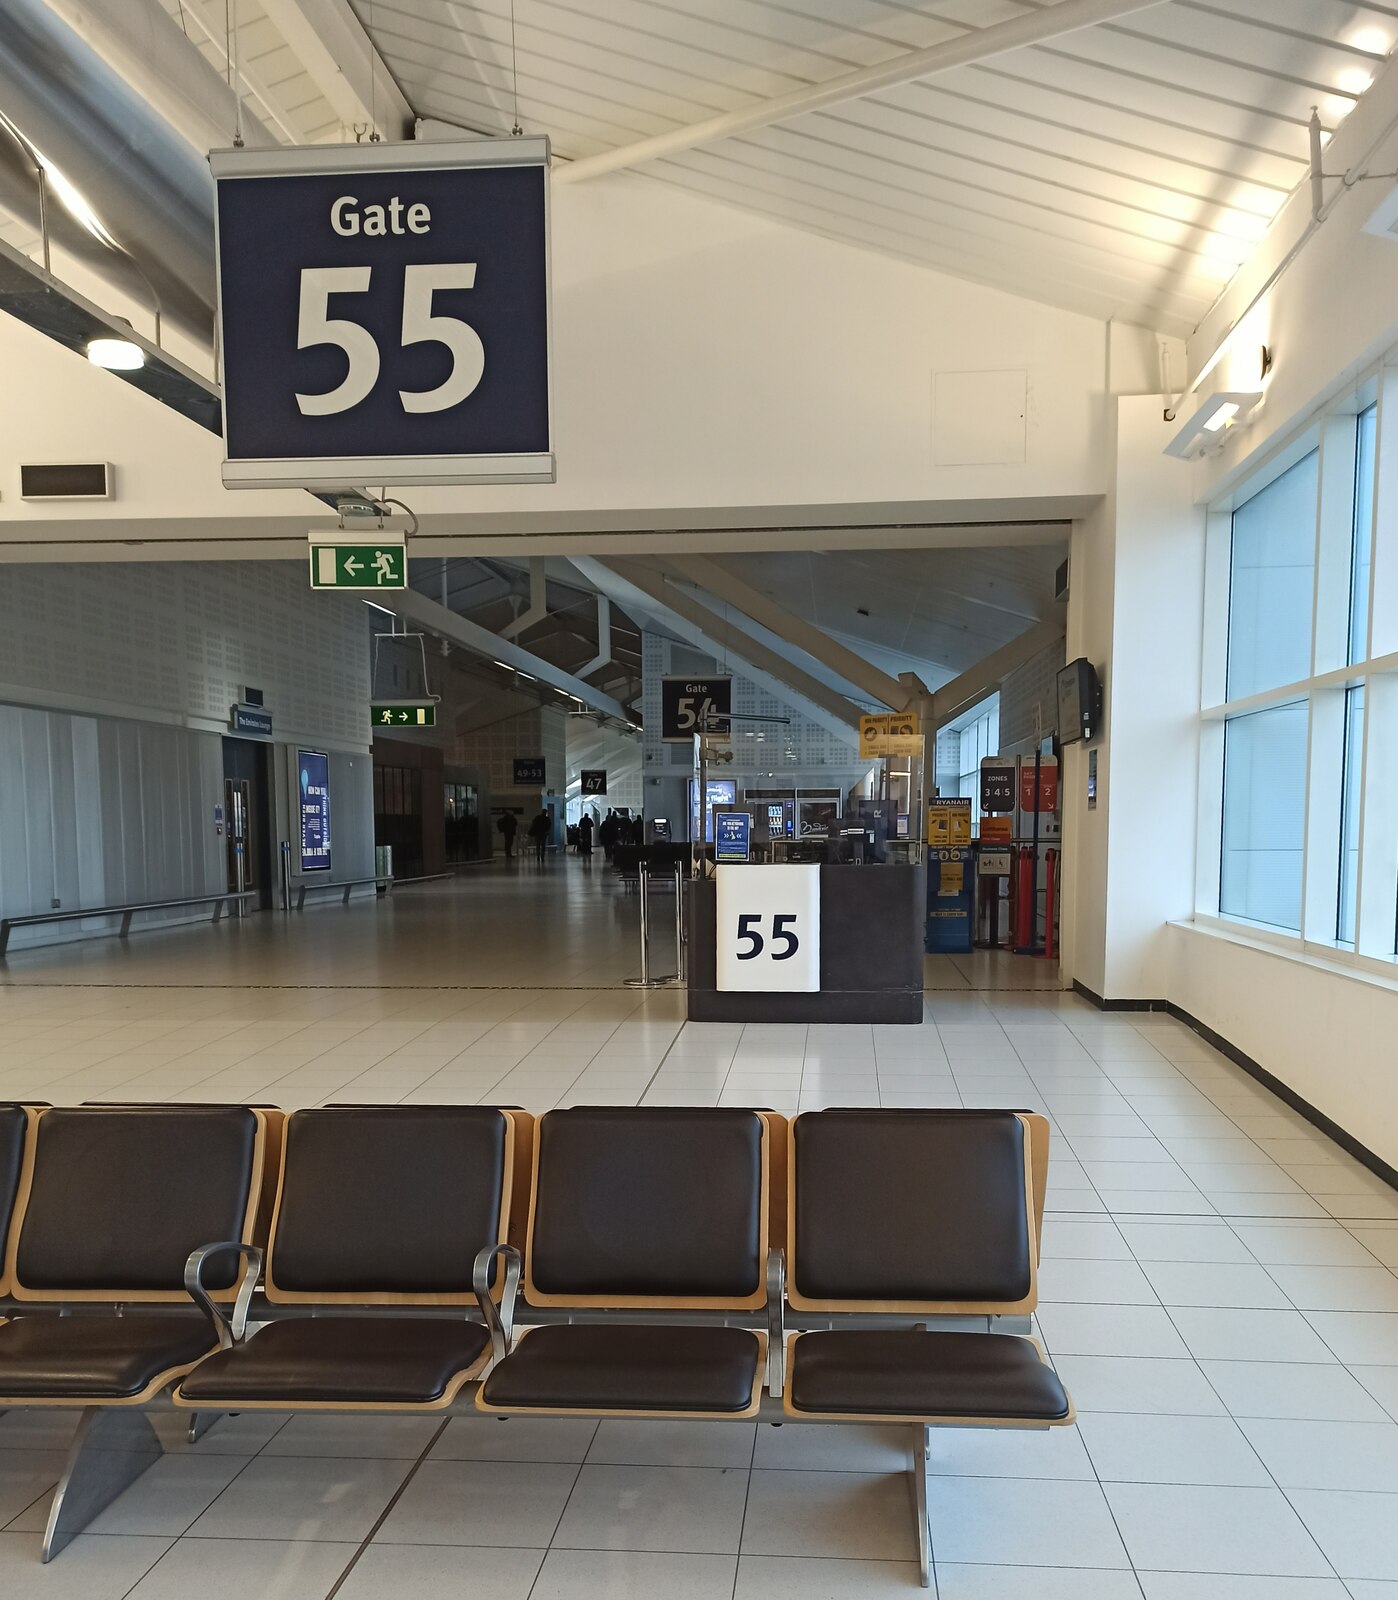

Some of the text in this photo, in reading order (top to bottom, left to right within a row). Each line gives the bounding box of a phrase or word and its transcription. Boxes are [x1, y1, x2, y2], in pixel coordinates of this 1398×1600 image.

[330, 195, 431, 236] Gate
[294, 262, 486, 417] 55
[685, 683, 708, 693] Gate
[676, 697, 720, 730] 54
[517, 768, 542, 777] 49-53
[586, 778, 602, 790] 47
[985, 788, 1011, 797] 3 4 5
[1025, 788, 1031, 797] 1
[1044, 788, 1051, 796] 2
[736, 914, 799, 960] 55
